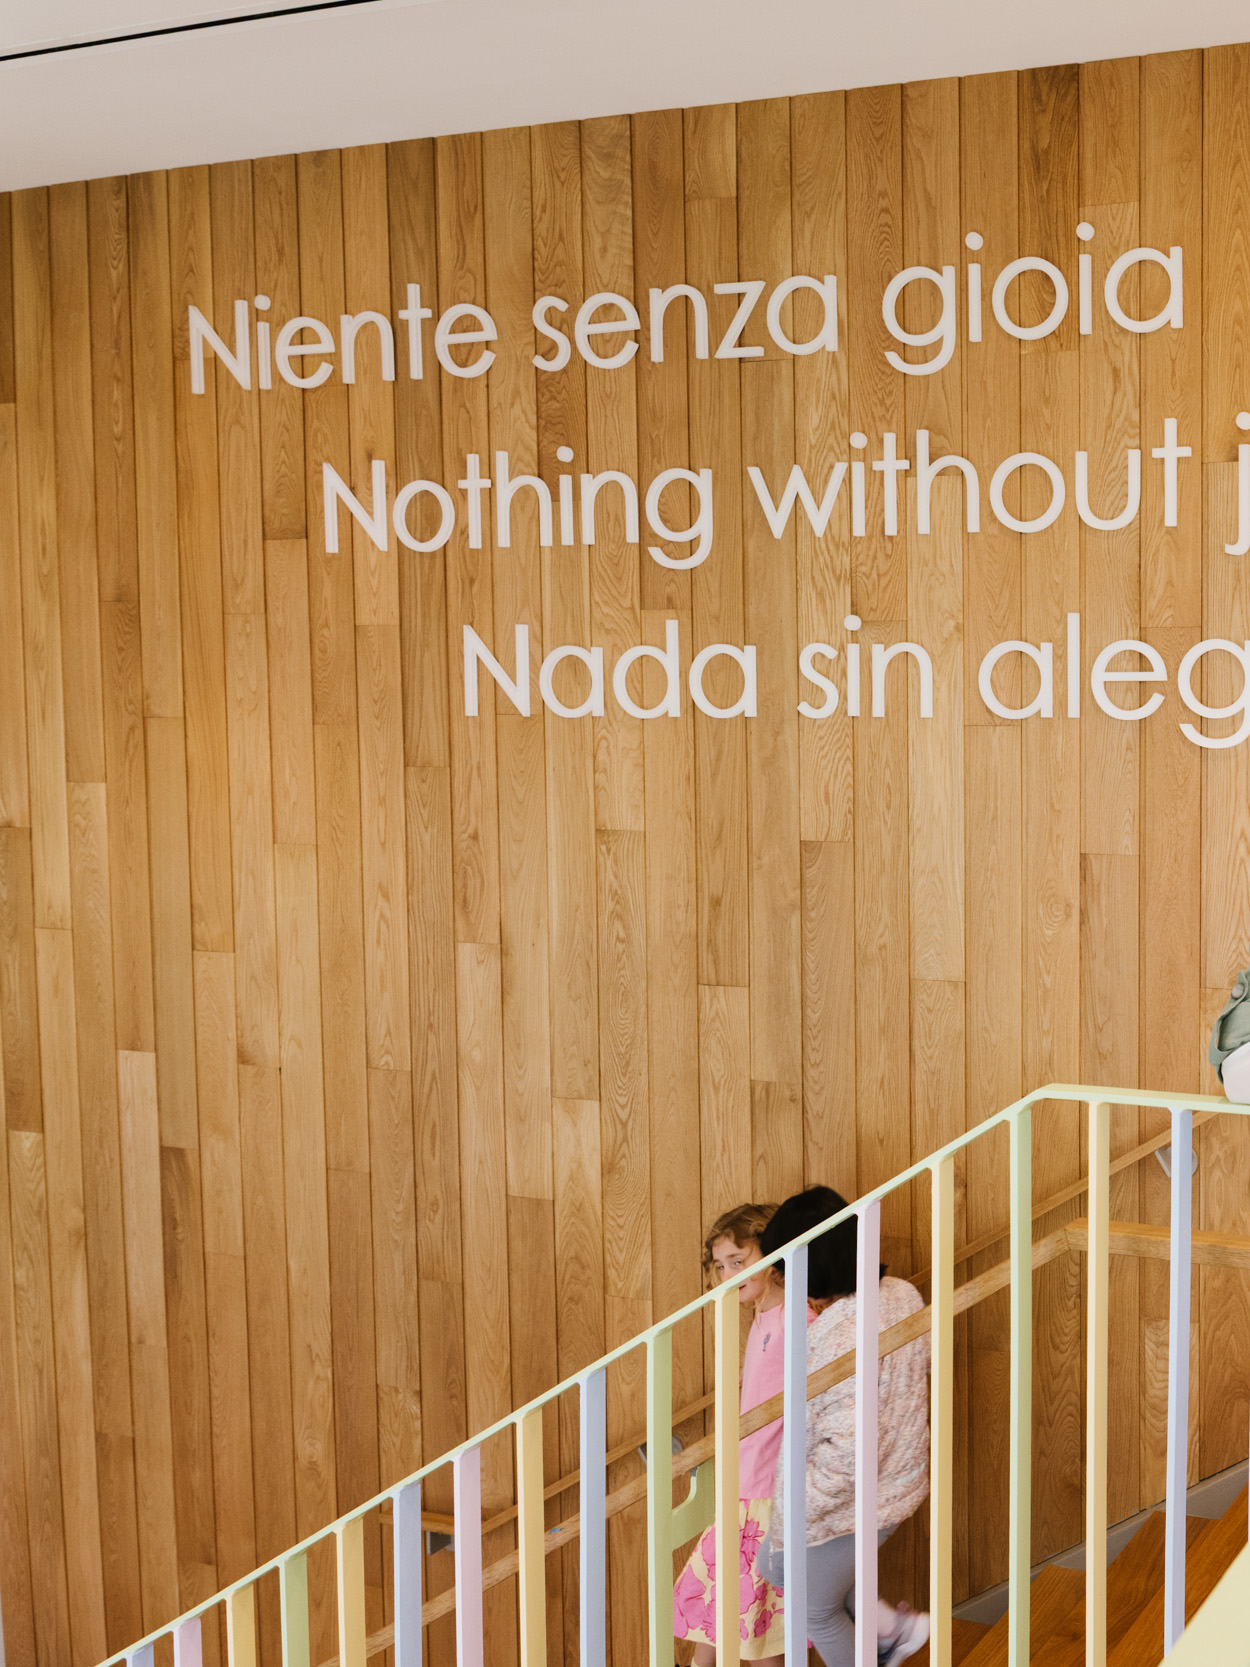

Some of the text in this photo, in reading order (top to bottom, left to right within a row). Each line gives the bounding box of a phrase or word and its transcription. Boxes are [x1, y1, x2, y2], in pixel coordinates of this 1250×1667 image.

[188, 222, 1184, 395] Niente senza gioia
[321, 446, 715, 570] Nothing
[747, 418, 1193, 540] without
[462, 618, 759, 720] Nada
[796, 614, 935, 720] sin
